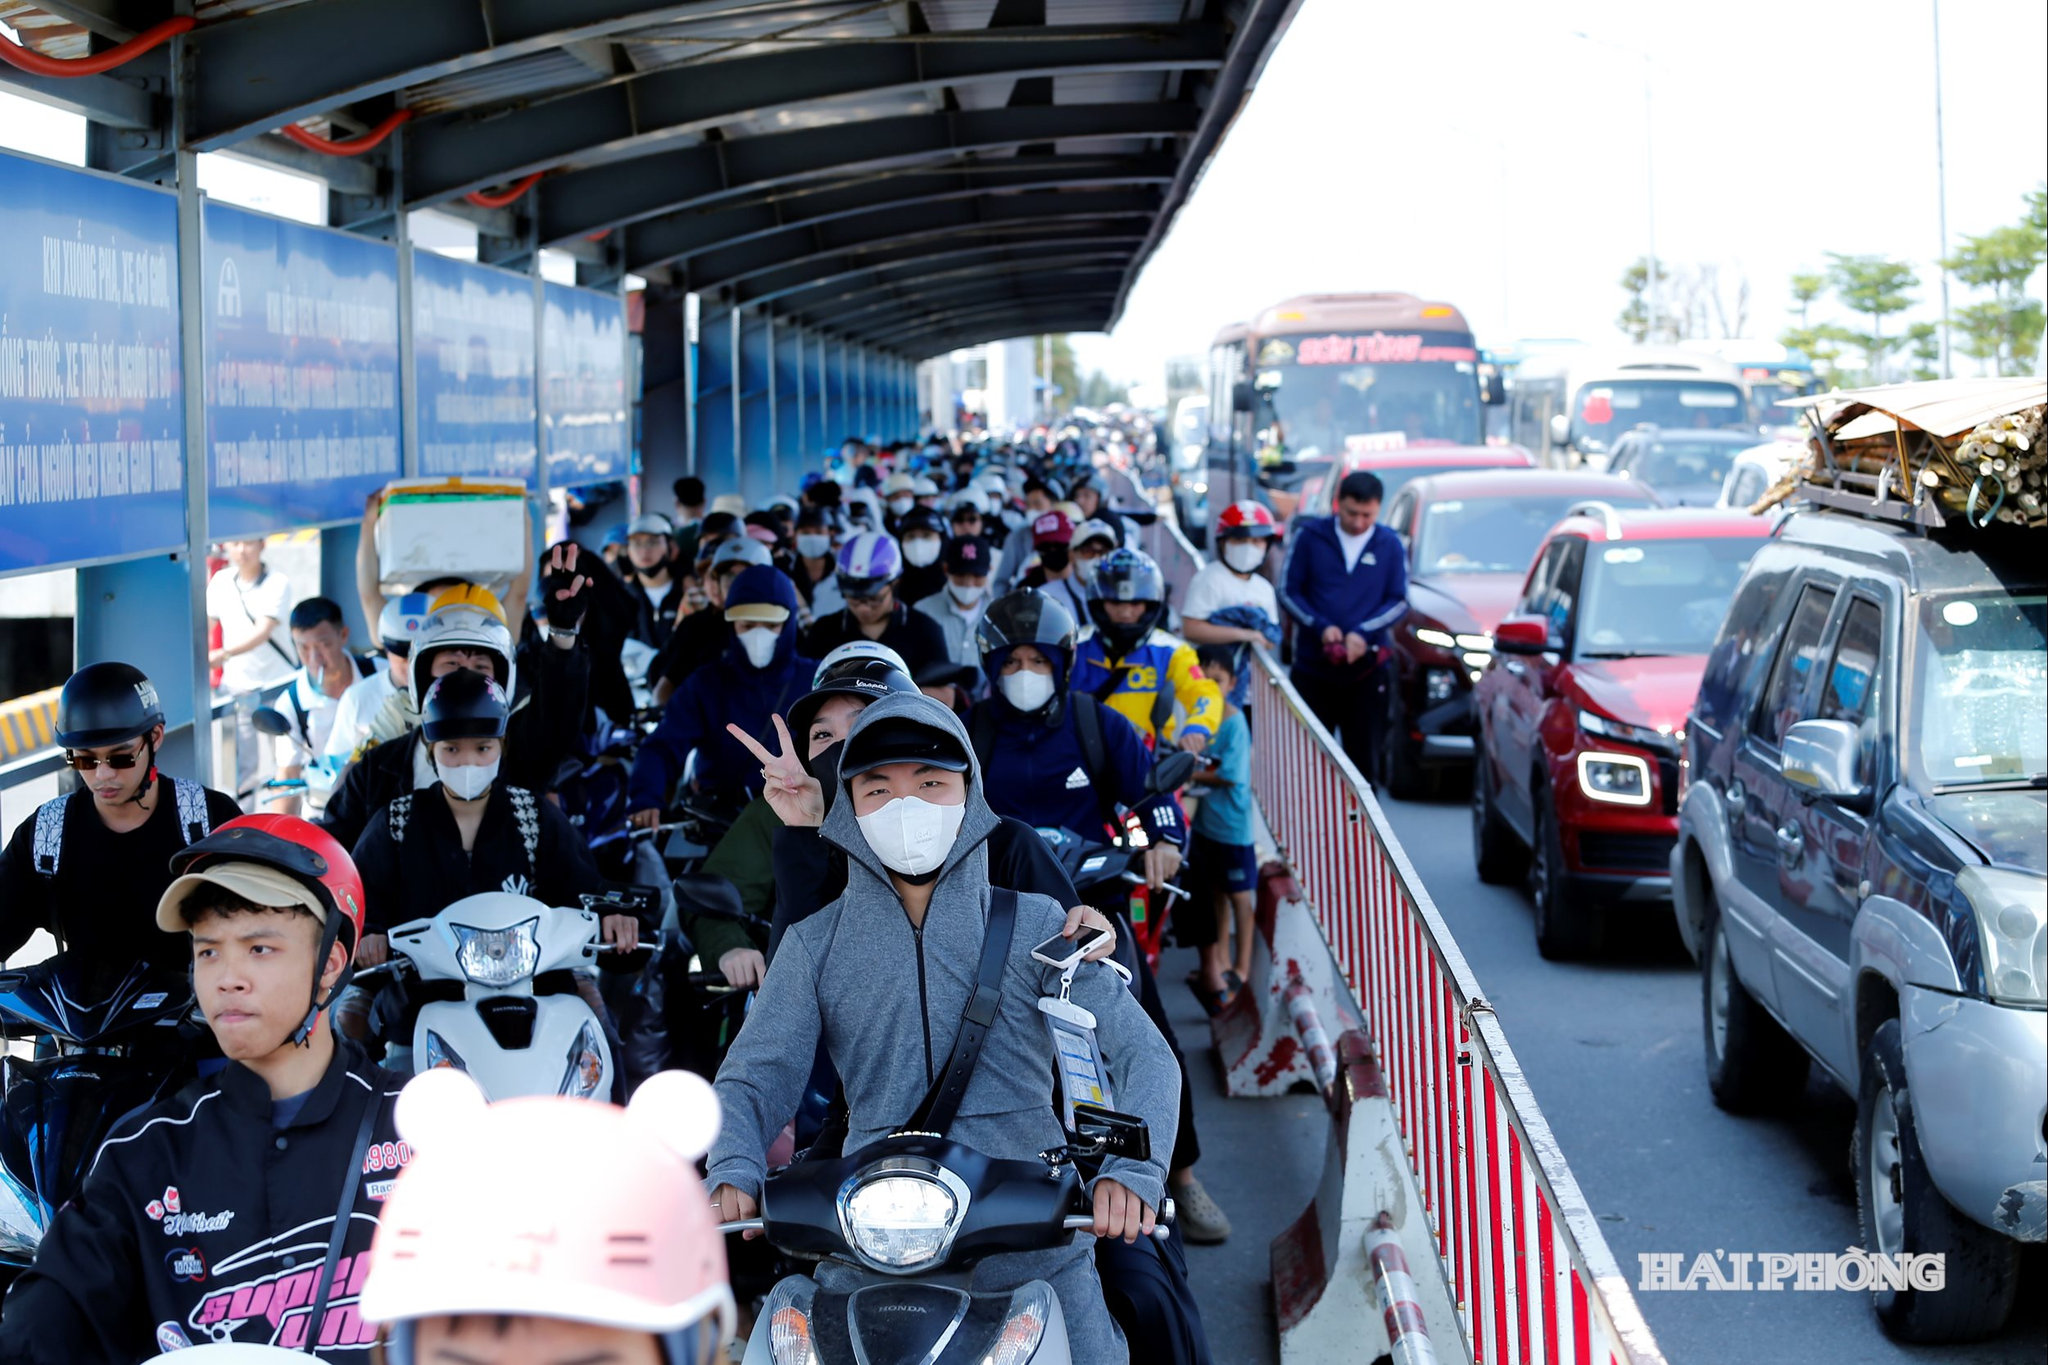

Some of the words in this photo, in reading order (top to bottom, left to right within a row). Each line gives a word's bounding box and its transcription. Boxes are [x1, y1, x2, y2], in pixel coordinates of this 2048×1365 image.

[43, 236, 60, 294] KHI
[63, 219, 97, 299] XUỐNG
[122, 250, 135, 304] XE
[27, 327, 64, 406] TRƯỚC,
[65, 340, 79, 398] XE
[80, 332, 99, 398] THÔ
[17, 423, 40, 505] CỦA
[41, 428, 74, 503] NGƯỜI
[75, 421, 98, 499] ĐIỀU
[878, 1305, 928, 1314] HONDA
